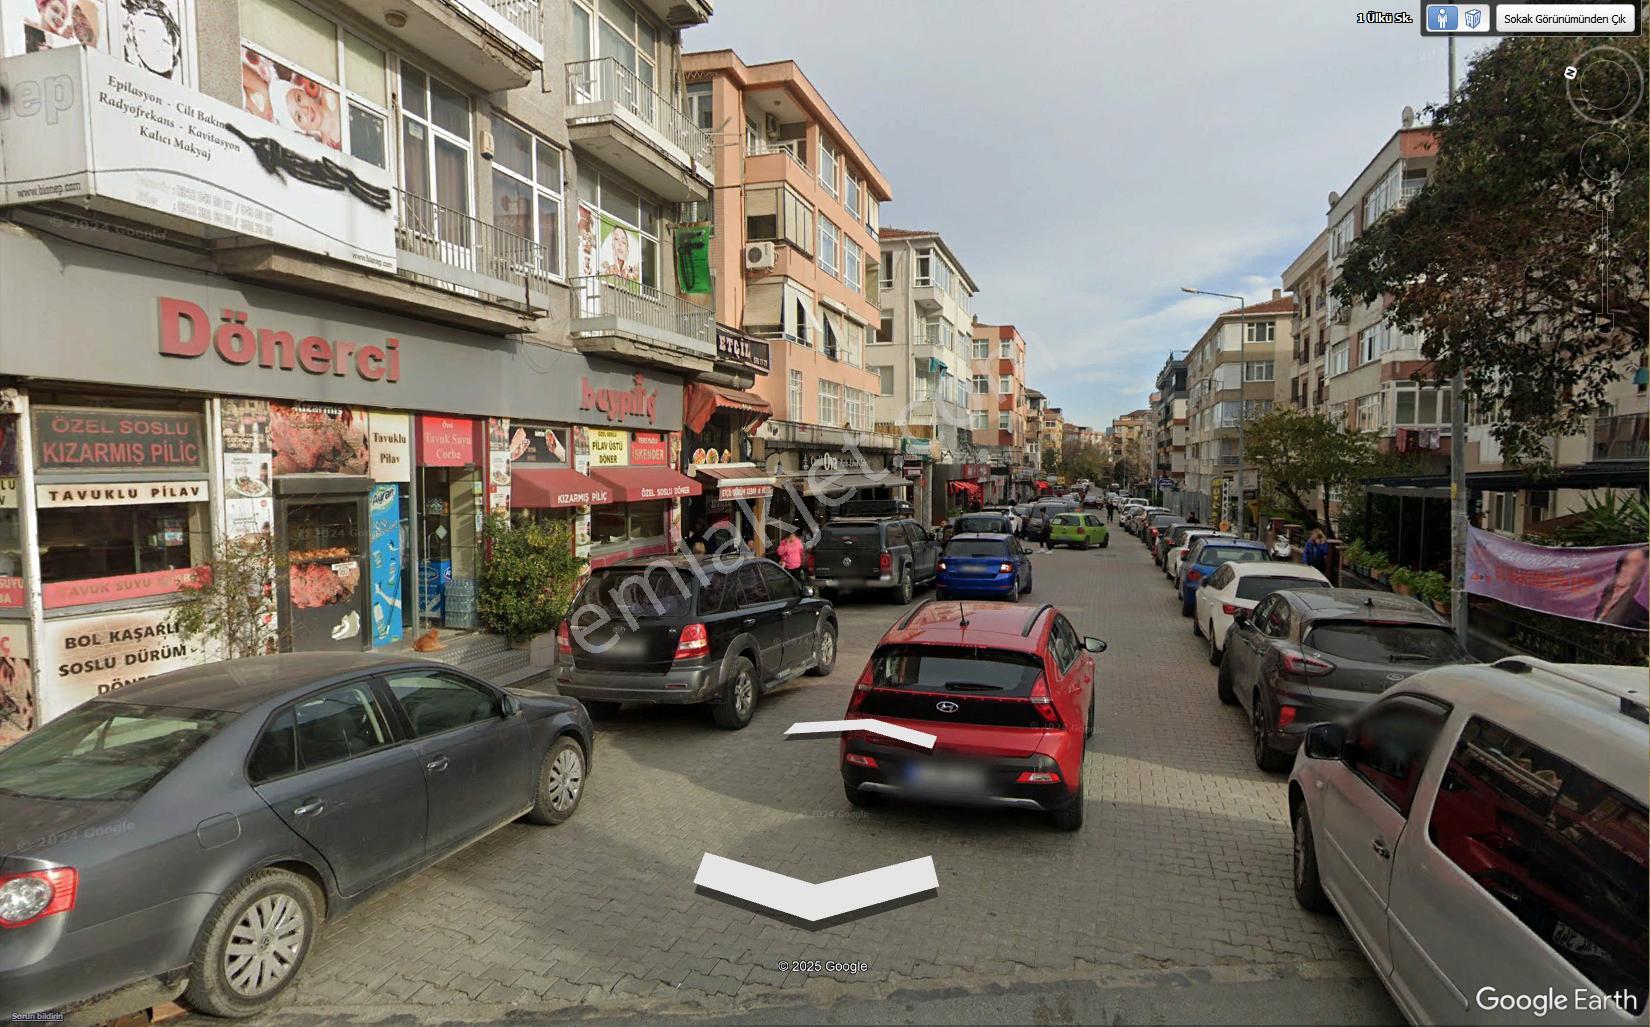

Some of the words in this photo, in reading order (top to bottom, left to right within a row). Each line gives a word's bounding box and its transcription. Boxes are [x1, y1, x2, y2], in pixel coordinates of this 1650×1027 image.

[108, 75, 162, 106] Epilasyon
[176, 102, 194, 117] Cilt
[99, 92, 175, 128] Radyofrekans
[188, 125, 240, 152] Kavitasyon
[140, 126, 171, 145] Kalıcı
[174, 137, 211, 161] Makyaj
[158, 296, 401, 382] Dönerci
[718, 334, 752, 359] ETÇİL
[52, 416, 113, 434] ÖZEL
[119, 420, 189, 436] SOSLU
[372, 432, 407, 444] Tavuklu
[592, 440, 608, 451] PİLAV
[609, 441, 623, 451] ÜSTÜ
[43, 441, 145, 466] KIZARMIŞ
[151, 441, 198, 464] PİLİÇ
[380, 453, 401, 464] Pilav
[48, 488, 138, 501] TAVUKLU
[151, 486, 200, 498] PİLAV
[557, 492, 589, 504] KIZARMIŞ
[591, 491, 608, 501] PİLİÇ
[641, 487, 656, 497] ÖZEL
[657, 487, 673, 497] SOSLU
[674, 486, 691, 496] DÖNER
[115, 579, 151, 592] SUYU
[65, 634, 101, 650] BOL
[109, 621, 181, 644] KAŞARLI
[59, 656, 116, 678] SOSLU
[125, 642, 187, 667] DÜRÜM
